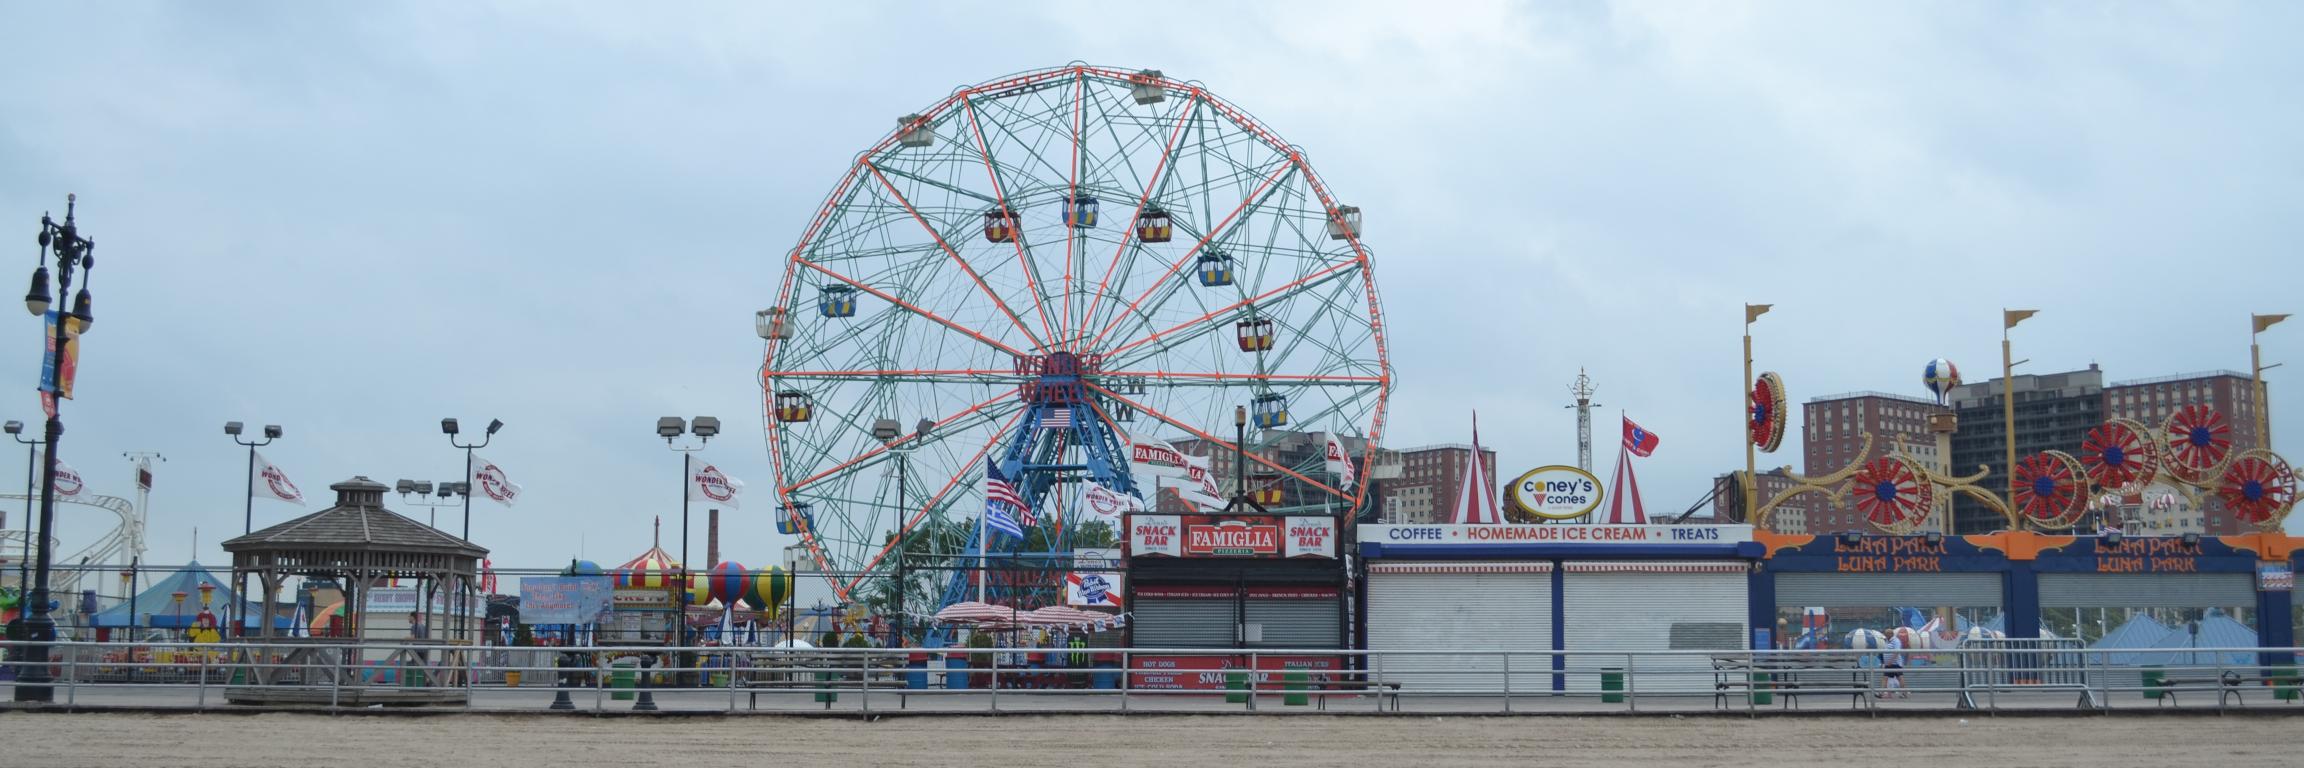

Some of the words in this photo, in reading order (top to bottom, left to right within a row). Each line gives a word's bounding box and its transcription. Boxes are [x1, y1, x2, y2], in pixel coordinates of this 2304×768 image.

[1013, 354, 1102, 375] WONDER
[1019, 382, 1096, 402] WHEEL
[1547, 495, 1586, 504] cones
[1136, 525, 1177, 536] SNACK
[1290, 527, 1330, 537] SNACK
[1389, 528, 1442, 540] COFFEE
[1467, 527, 1558, 540] HOMEMADE
[1562, 527, 1587, 540] ICE
[1591, 527, 1647, 540] CREAM
[1671, 528, 1719, 540] TREATS
[1144, 536, 1168, 546] BAR
[1192, 531, 1273, 547] FAMIGLIA
[1298, 537, 1322, 546] BAR
[1837, 556, 1886, 571] LUNA
[1893, 556, 1941, 571] PARK
[2097, 557, 2144, 571] LUNA
[2150, 557, 2197, 571] PARK
[1199, 672, 1226, 684] SNA
